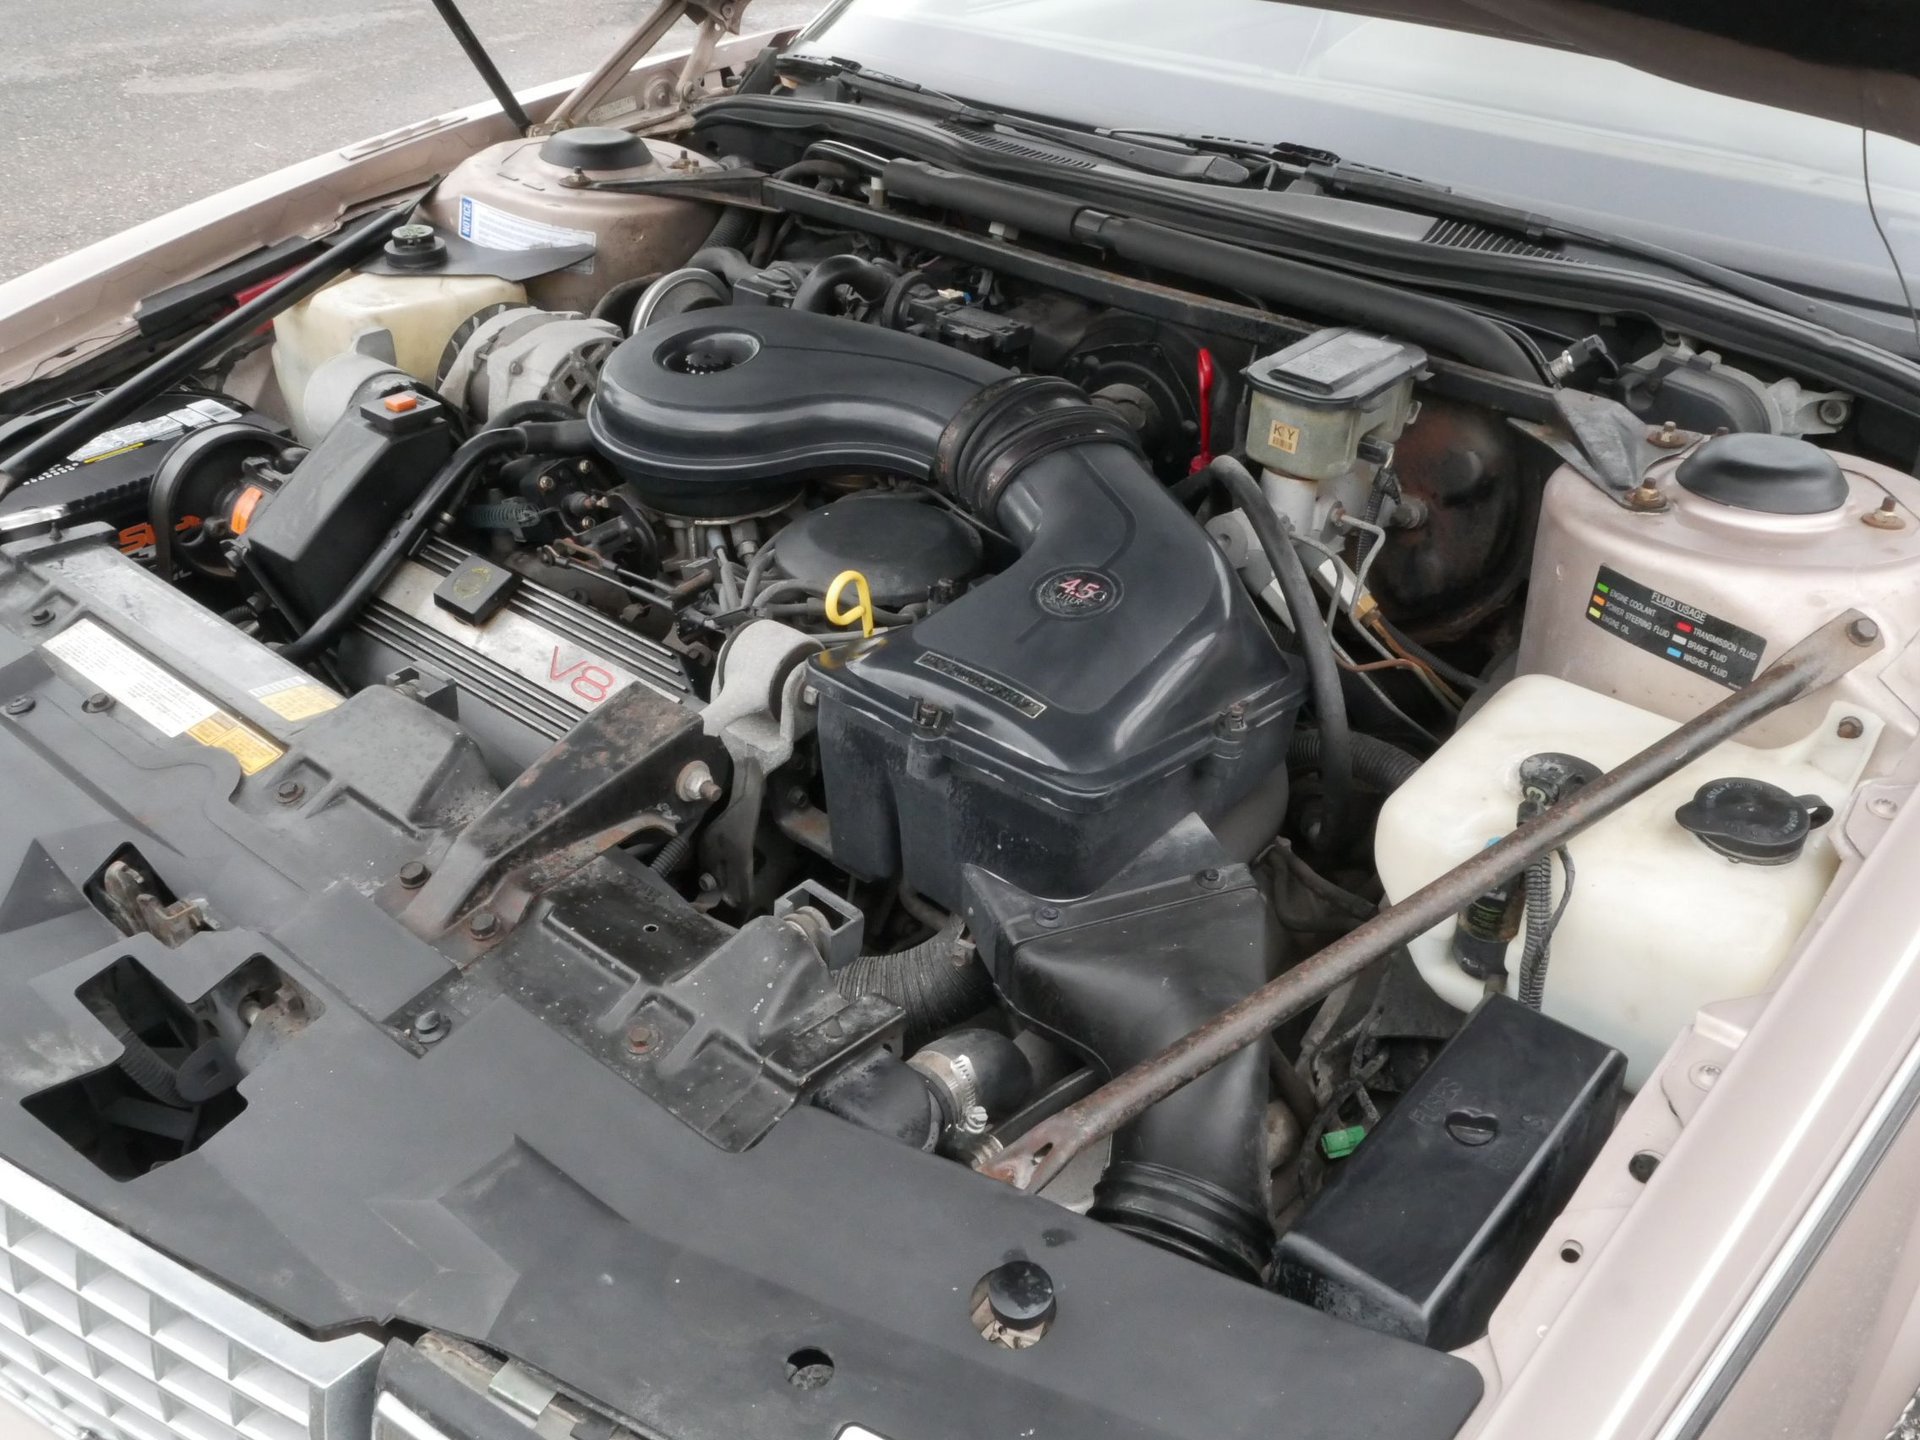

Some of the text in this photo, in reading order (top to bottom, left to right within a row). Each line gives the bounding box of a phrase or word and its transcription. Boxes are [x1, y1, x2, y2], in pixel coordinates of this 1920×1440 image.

[462, 198, 472, 236] NOTICE
[1057, 592, 1083, 605] LITER
[1059, 577, 1100, 599] 4.5
[1610, 589, 1657, 617] ENGINE COOLANT
[1651, 592, 1707, 622] FLUID USAGE
[1601, 614, 1630, 635] ENGINE OIL
[1606, 601, 1670, 638] POWER STEERING FLUID
[1687, 640, 1728, 663] BRAKE FLUID
[1693, 627, 1758, 661] TRANSMISSION FLUID
[550, 645, 616, 703] V8
[1683, 653, 1728, 678] WASHER FLUID
